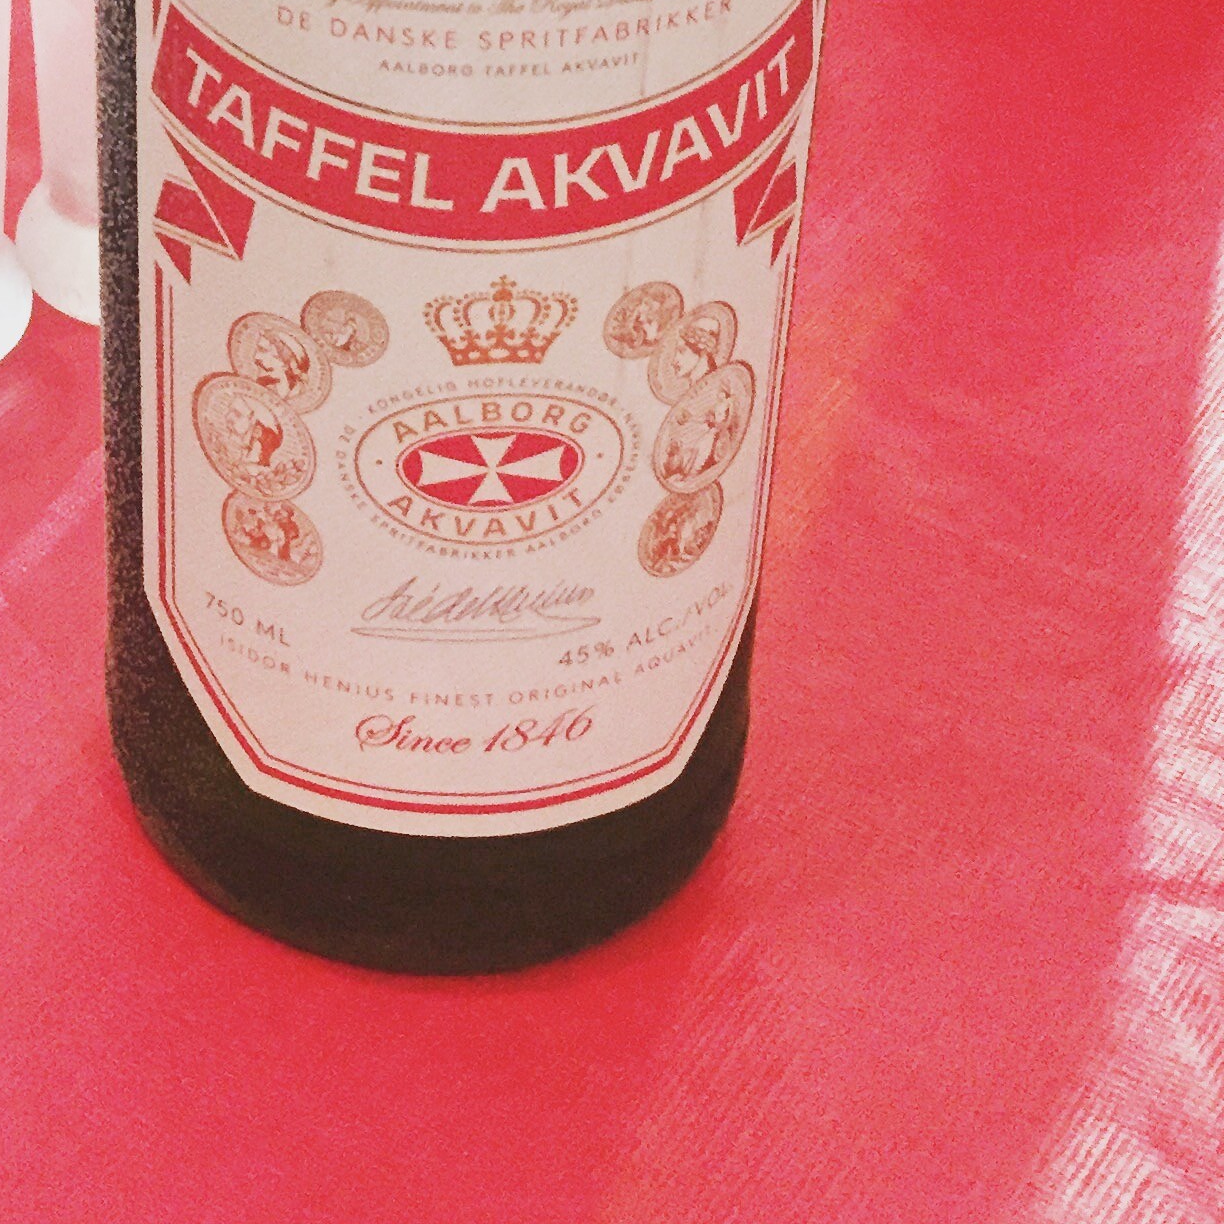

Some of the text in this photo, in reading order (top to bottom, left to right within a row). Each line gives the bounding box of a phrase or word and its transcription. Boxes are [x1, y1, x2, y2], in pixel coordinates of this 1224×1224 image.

[277, 5, 311, 31] DE
[330, 17, 458, 50] DANSKE
[378, 51, 639, 77] AALBORG TAFFEL AKVAVIT
[182, 37, 797, 213] TAFFEL AKVAVIT
[391, 401, 592, 444] AALBORG
[386, 487, 583, 539] AKVAVIT
[204, 591, 291, 648] 750 ML
[219, 634, 292, 675] ISIDOR
[303, 670, 395, 703] HENIUS
[409, 691, 495, 709] FINEST
[508, 671, 623, 706] ORIGINAL
[558, 639, 616, 667] 45%
[354, 702, 597, 754] Since 1846
